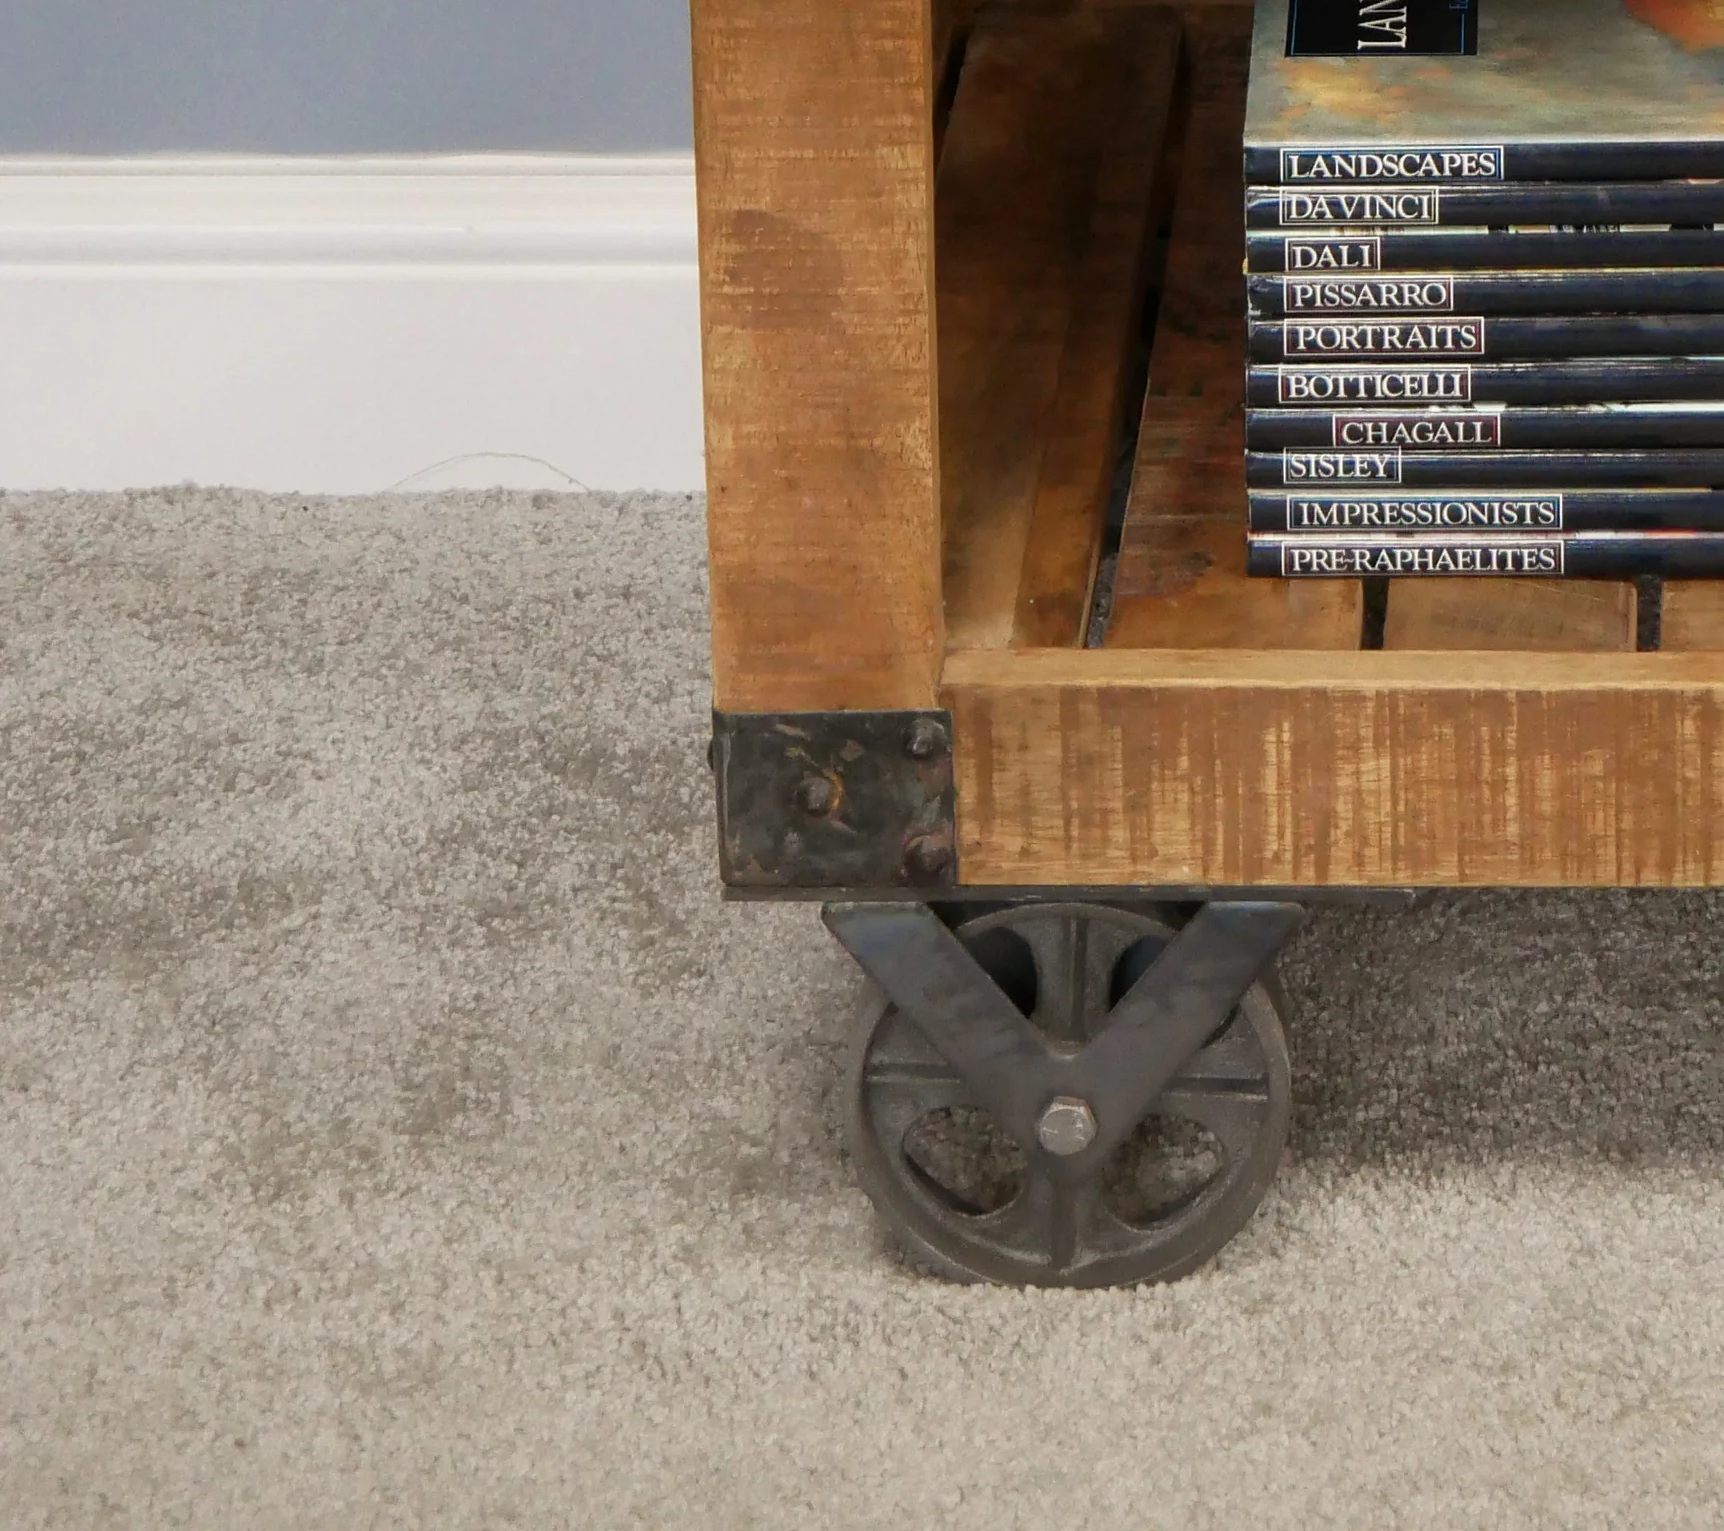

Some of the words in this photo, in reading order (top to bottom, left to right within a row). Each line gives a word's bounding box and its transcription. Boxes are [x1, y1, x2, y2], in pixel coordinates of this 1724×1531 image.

[1289, 152, 1496, 178] LANDSCAPES
[1292, 245, 1370, 269] DALI
[1293, 283, 1446, 307] PISSARRO
[1296, 325, 1476, 349] PORTRAITS
[1288, 374, 1462, 397] BOTTICELLI
[1342, 421, 1492, 444] CHAGALL
[1290, 454, 1390, 477] SISLEY
[1300, 501, 1554, 525] IMPRESSIONISTS
